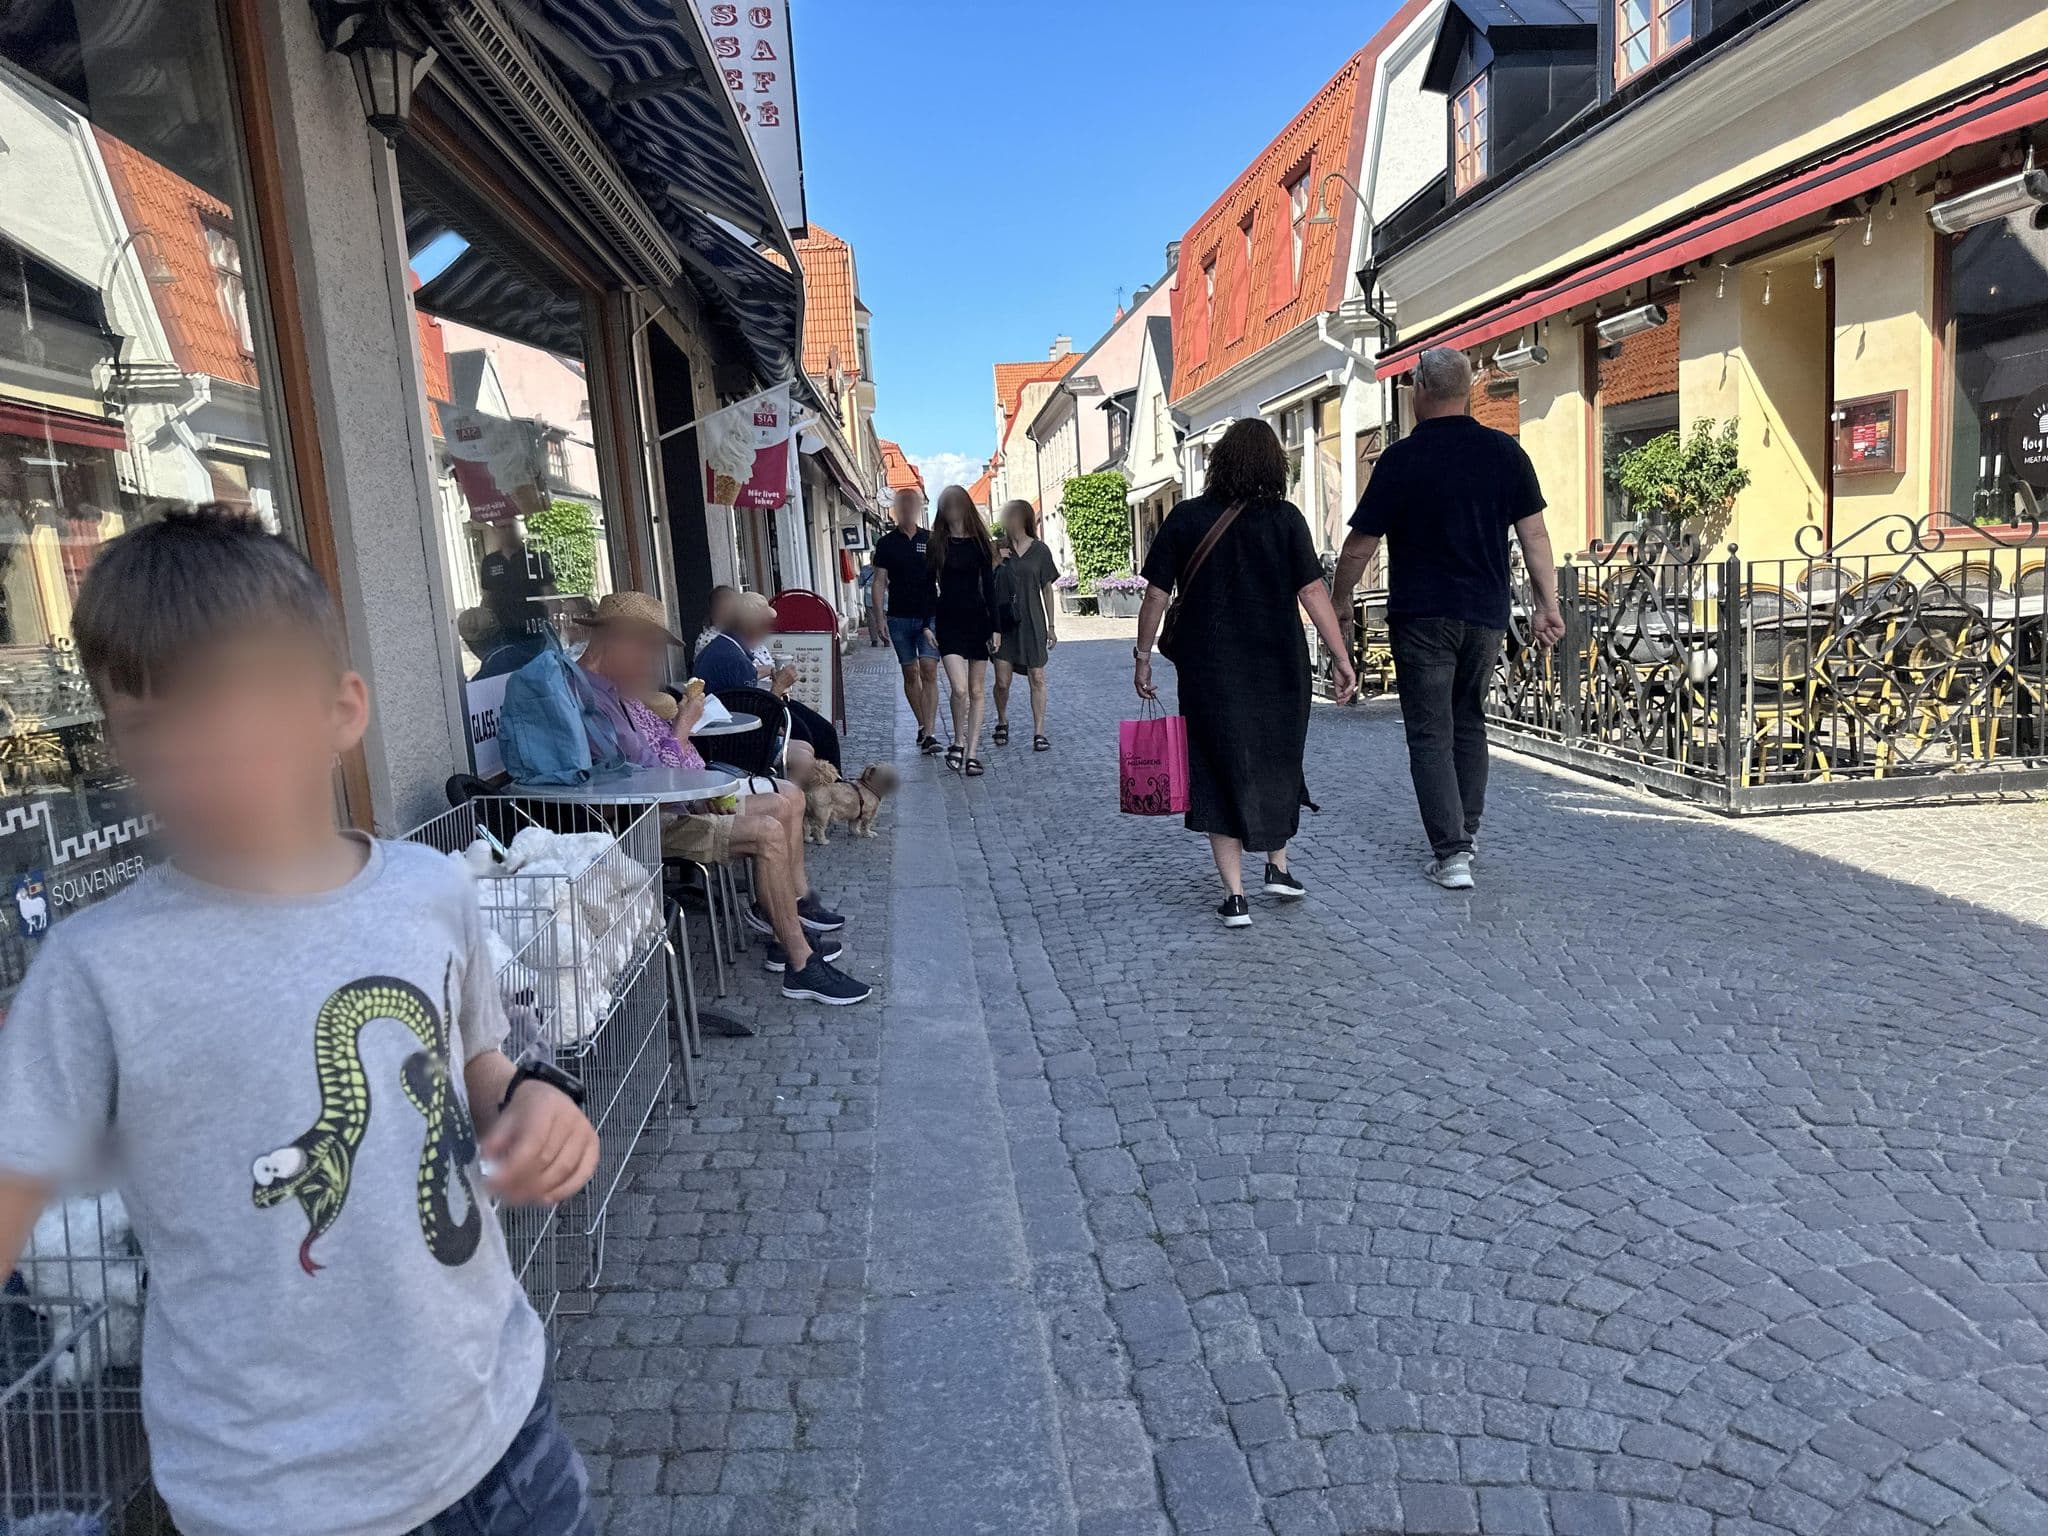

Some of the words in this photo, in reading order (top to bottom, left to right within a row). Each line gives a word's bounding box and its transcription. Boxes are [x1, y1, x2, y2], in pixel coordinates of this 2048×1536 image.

[749, 7, 779, 127] CAFÉ
[757, 414, 774, 424] SIA
[2024, 455, 2041, 465] MEAT
[471, 708, 497, 744] GLASS
[52, 855, 145, 906] SOUVENIRER
